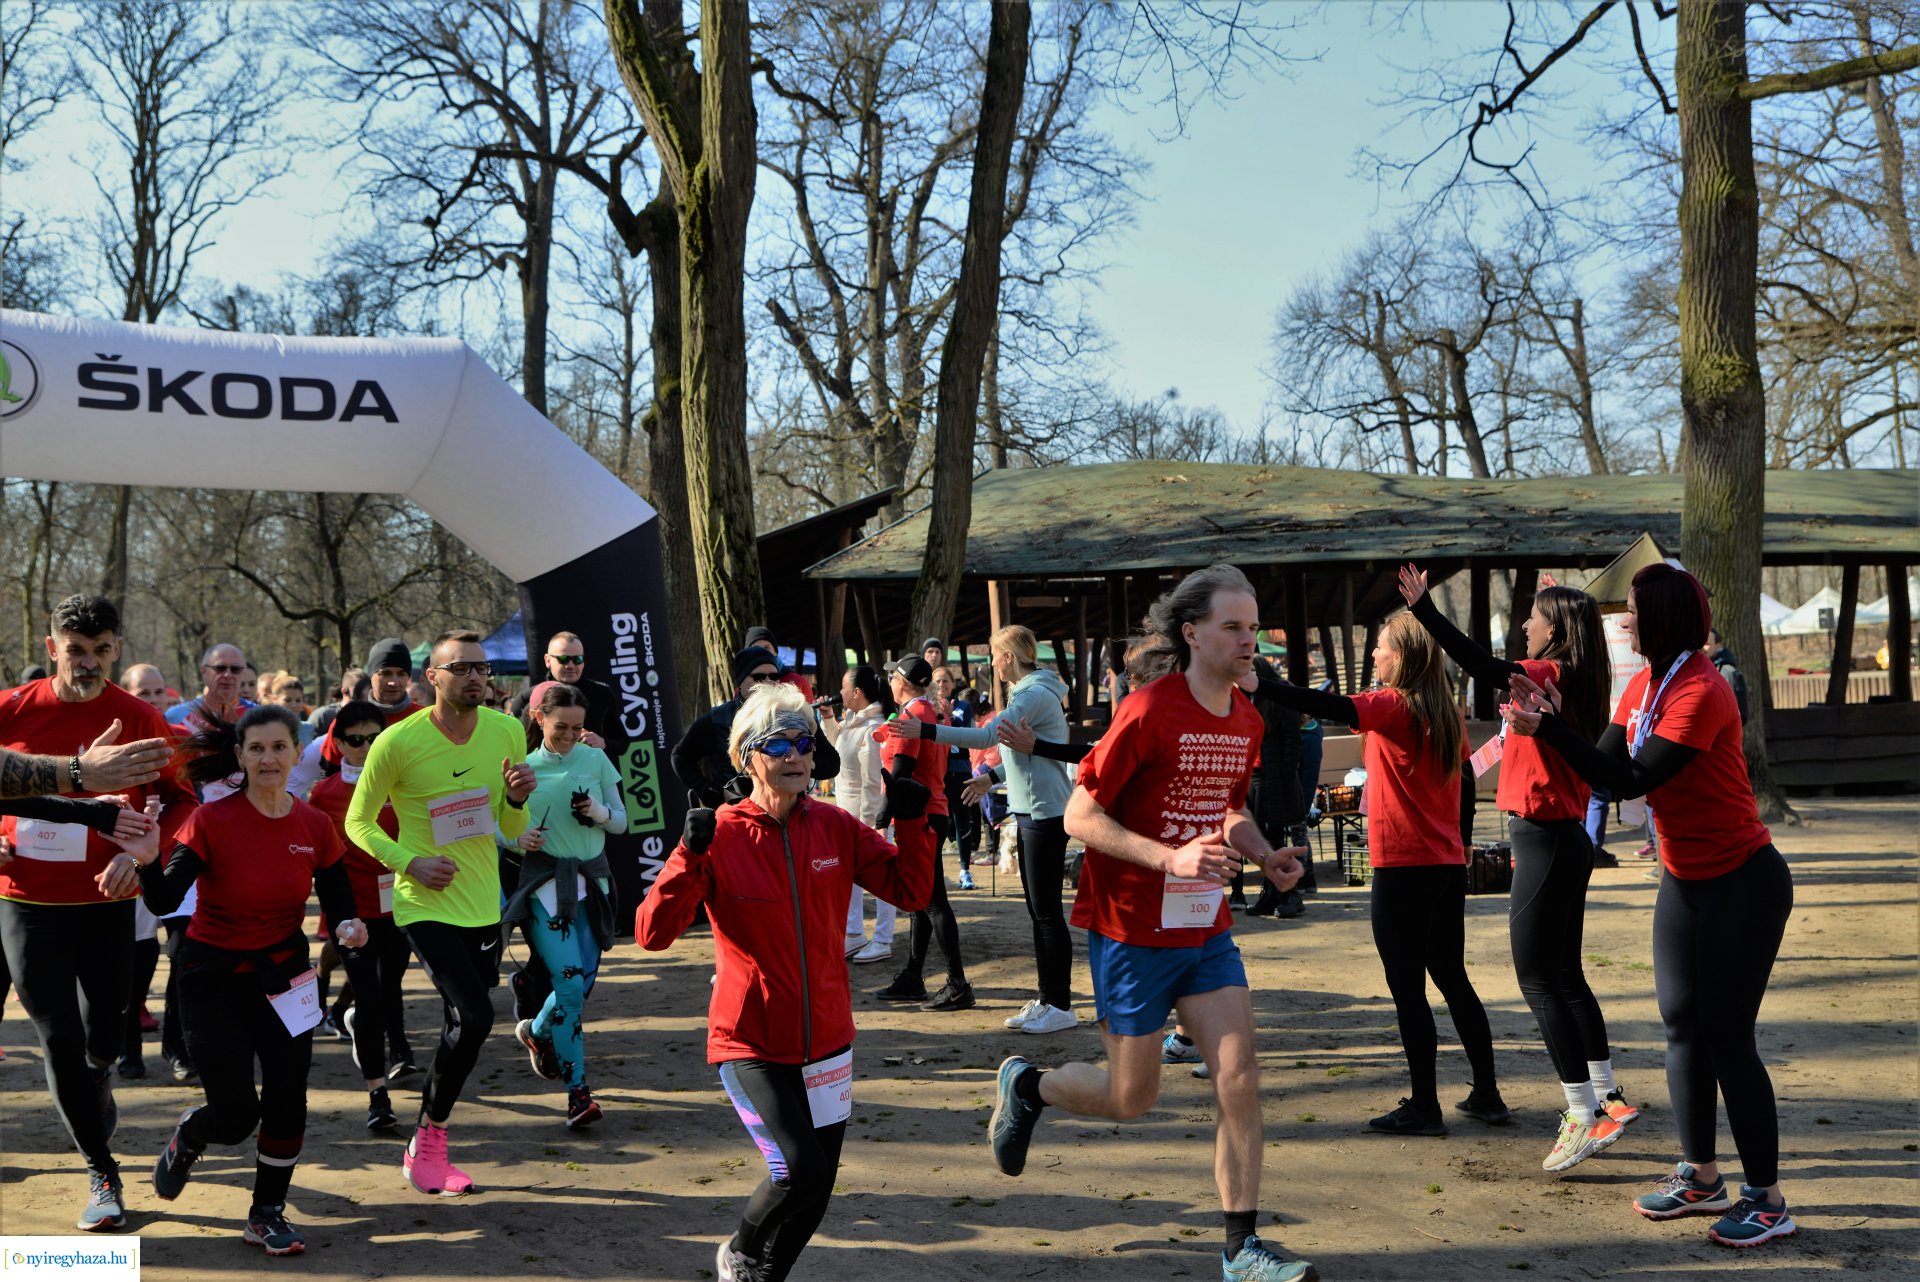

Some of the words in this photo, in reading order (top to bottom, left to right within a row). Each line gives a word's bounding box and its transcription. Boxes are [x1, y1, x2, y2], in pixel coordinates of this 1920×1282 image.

[78, 352, 400, 423] ŠKODA
[640, 611, 655, 667] ŠKODA
[610, 612, 648, 738] Cycling
[626, 748, 660, 826] Love
[37, 831, 57, 841] 407
[457, 817, 475, 828] 108
[638, 836, 669, 896] We
[1190, 903, 1210, 913] 100
[301, 993, 314, 1006] 417
[811, 1075, 832, 1087] SPURI
